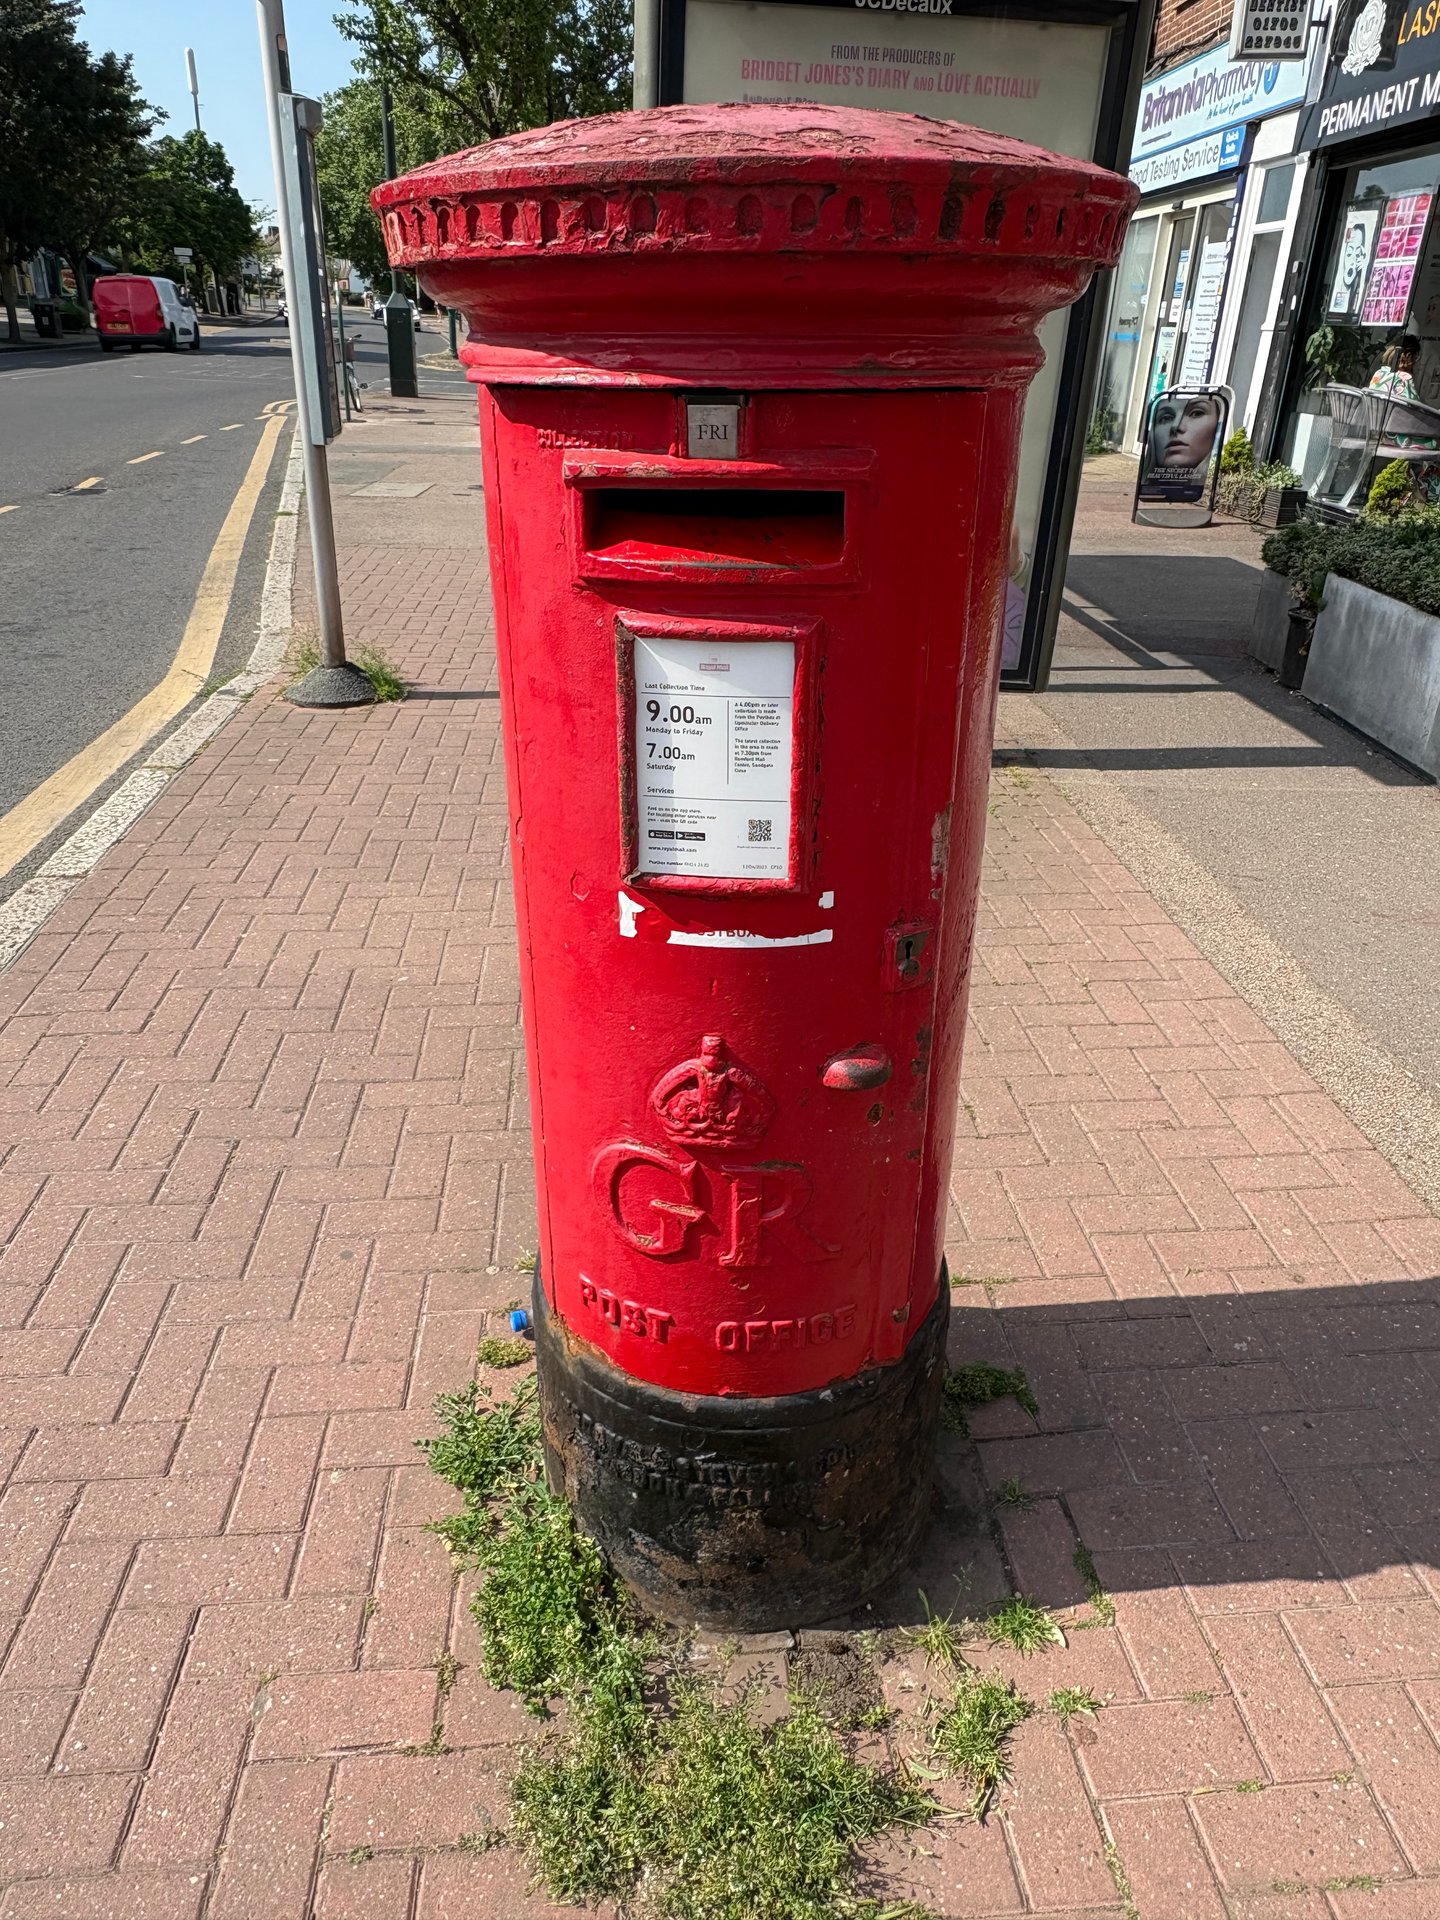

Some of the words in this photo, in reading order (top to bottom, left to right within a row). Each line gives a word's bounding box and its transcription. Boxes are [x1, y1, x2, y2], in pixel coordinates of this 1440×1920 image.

[1249, 0, 1308, 12] DENTIST
[1253, 17, 1298, 31] 01708
[831, 45, 860, 61] FROM
[862, 46, 880, 62] THE
[882, 48, 941, 65] PRODUCERS
[944, 52, 956, 66] OF
[741, 59, 802, 83] BRIDGET
[804, 63, 864, 87] JONES'S
[867, 67, 910, 90] DIARY
[913, 77, 933, 92] AND
[937, 71, 971, 94] LOVE
[973, 75, 1041, 99] ACTUALLY
[1318, 77, 1420, 138] PERMANENT
[1420, 70, 1440, 108] M
[1150, 154, 1178, 182] Testing
[1181, 142, 1219, 171] Service
[697, 424, 728, 440] FRI
[659, 682, 688, 690] Collection
[646, 699, 712, 724] 9.00am
[646, 726, 671, 735] Monday
[683, 728, 703, 736] Friday
[646, 743, 695, 760] 7.00am
[647, 763, 676, 771] Saturday
[647, 786, 674, 794] Services
[579, 1273, 677, 1344] POST
[715, 1304, 858, 1352] OFFICE
